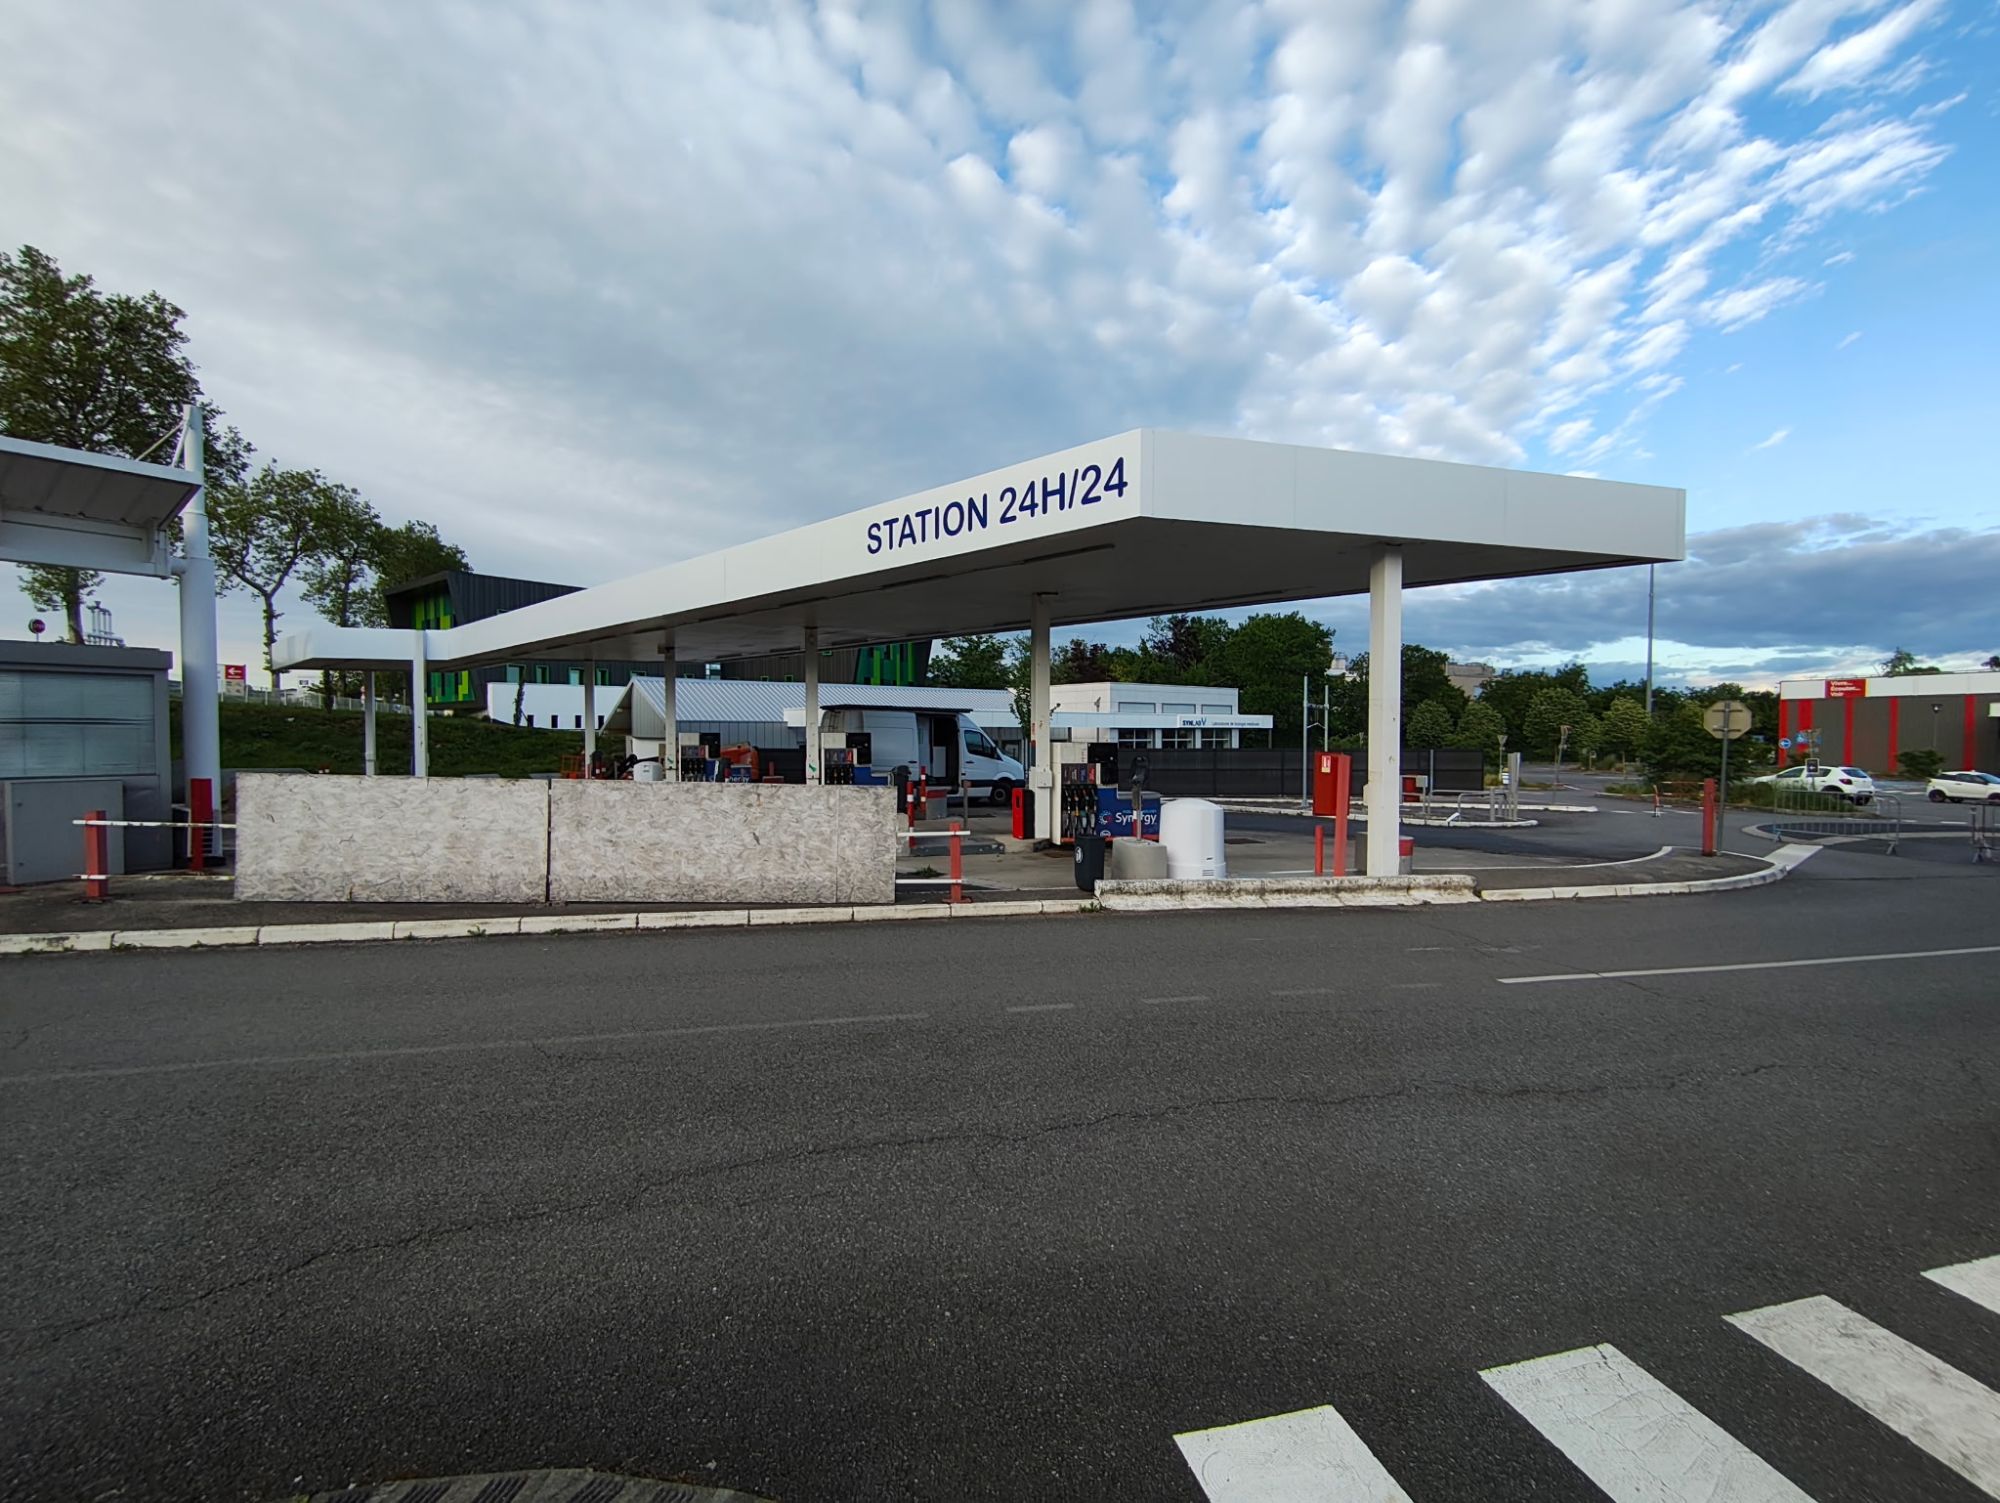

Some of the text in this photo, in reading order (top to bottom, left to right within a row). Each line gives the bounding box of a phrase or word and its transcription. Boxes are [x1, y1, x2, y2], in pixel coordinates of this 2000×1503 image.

[867, 456, 1128, 554] STATION 24H/24
[1115, 812, 1157, 825] Synrgy
